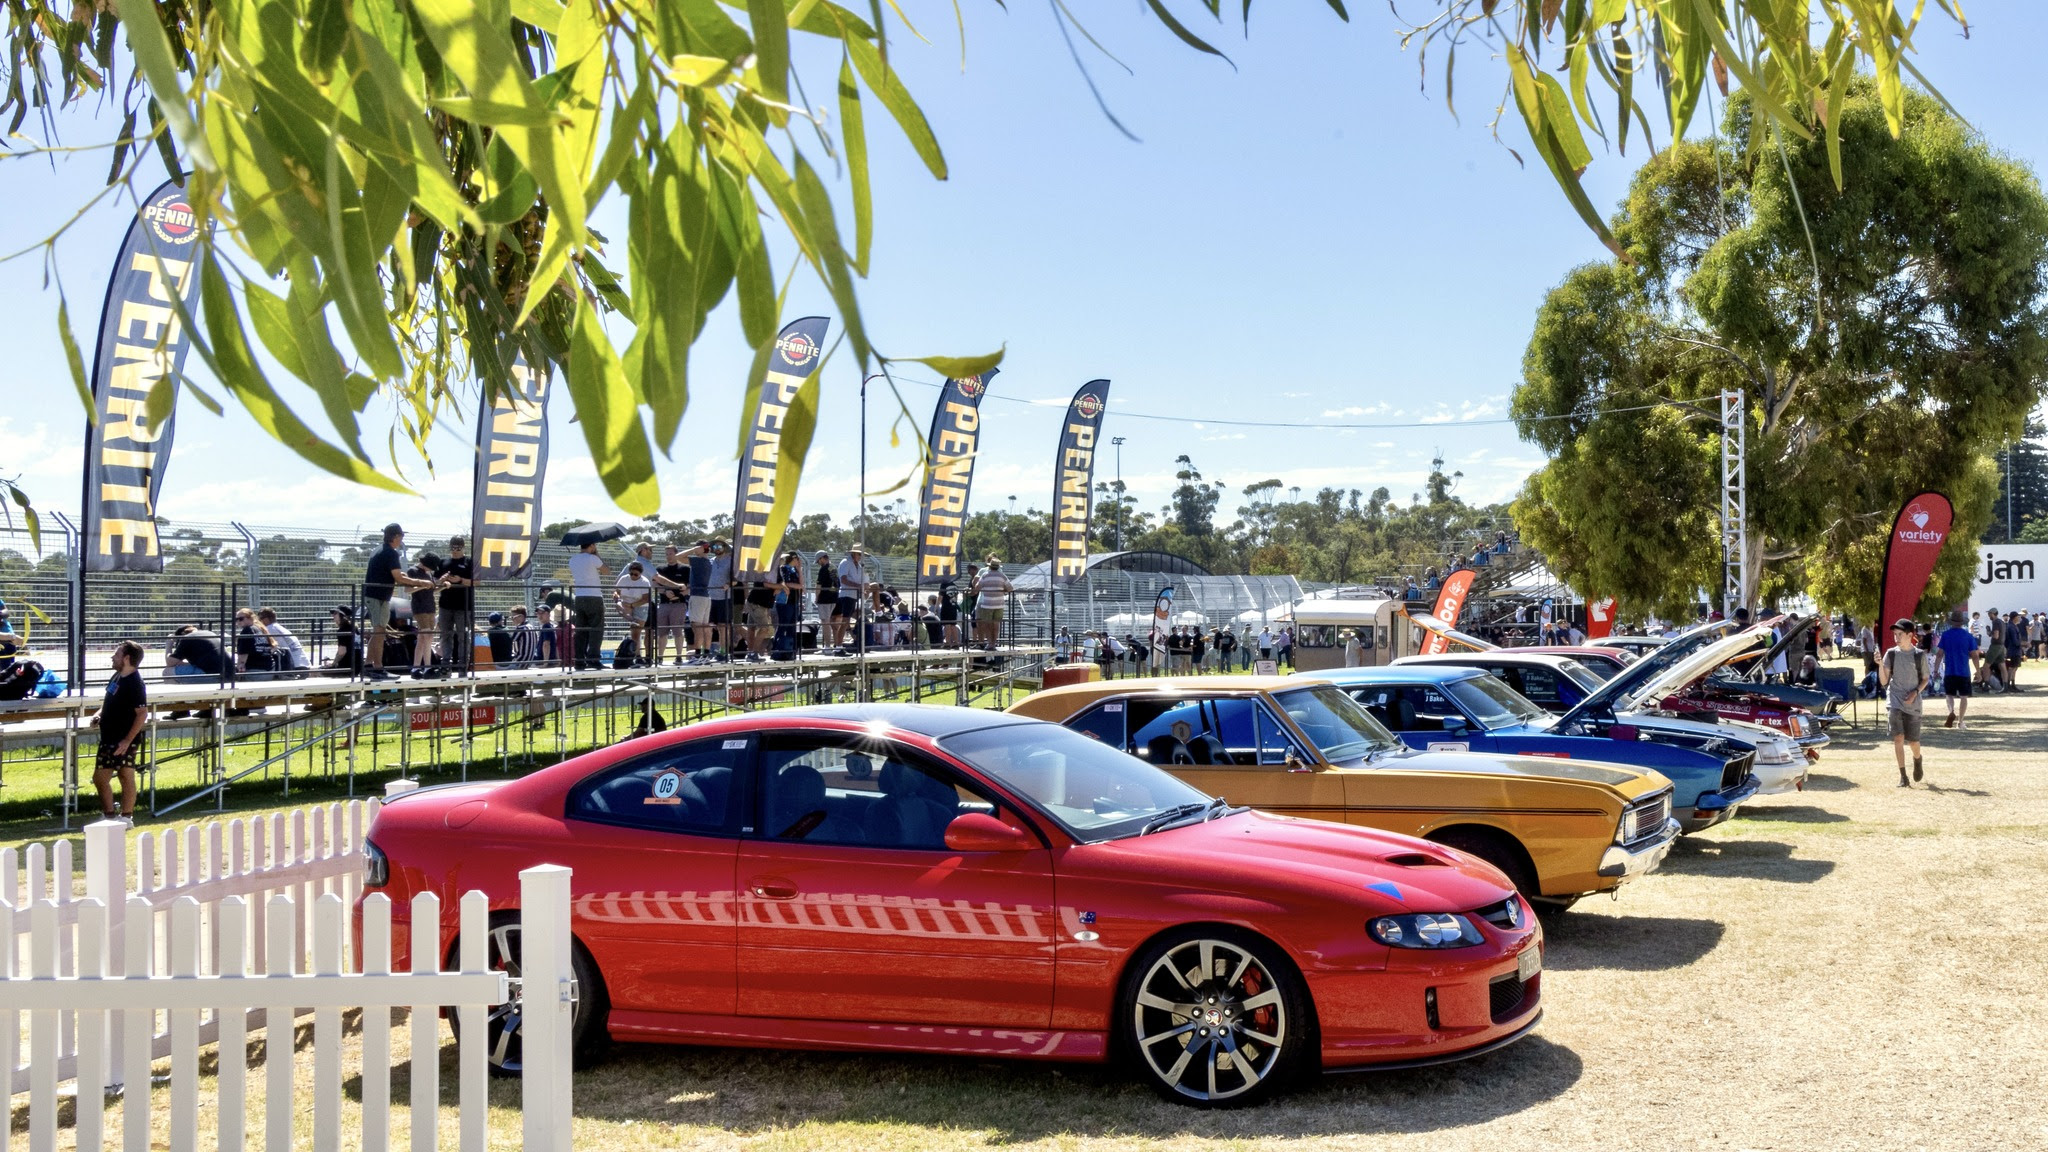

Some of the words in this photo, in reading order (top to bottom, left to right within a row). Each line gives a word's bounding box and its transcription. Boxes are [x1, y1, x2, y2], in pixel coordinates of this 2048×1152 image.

[775, 339, 820, 358] PENRITE
[1074, 400, 1104, 411] PENRITE
[922, 401, 979, 576] PENRITE
[1057, 423, 1096, 577] PENRITE
[1899, 530, 1942, 543] variety
[1979, 553, 2034, 584] jam
[1754, 717, 1782, 726] protex
[660, 779, 674, 793] 05
